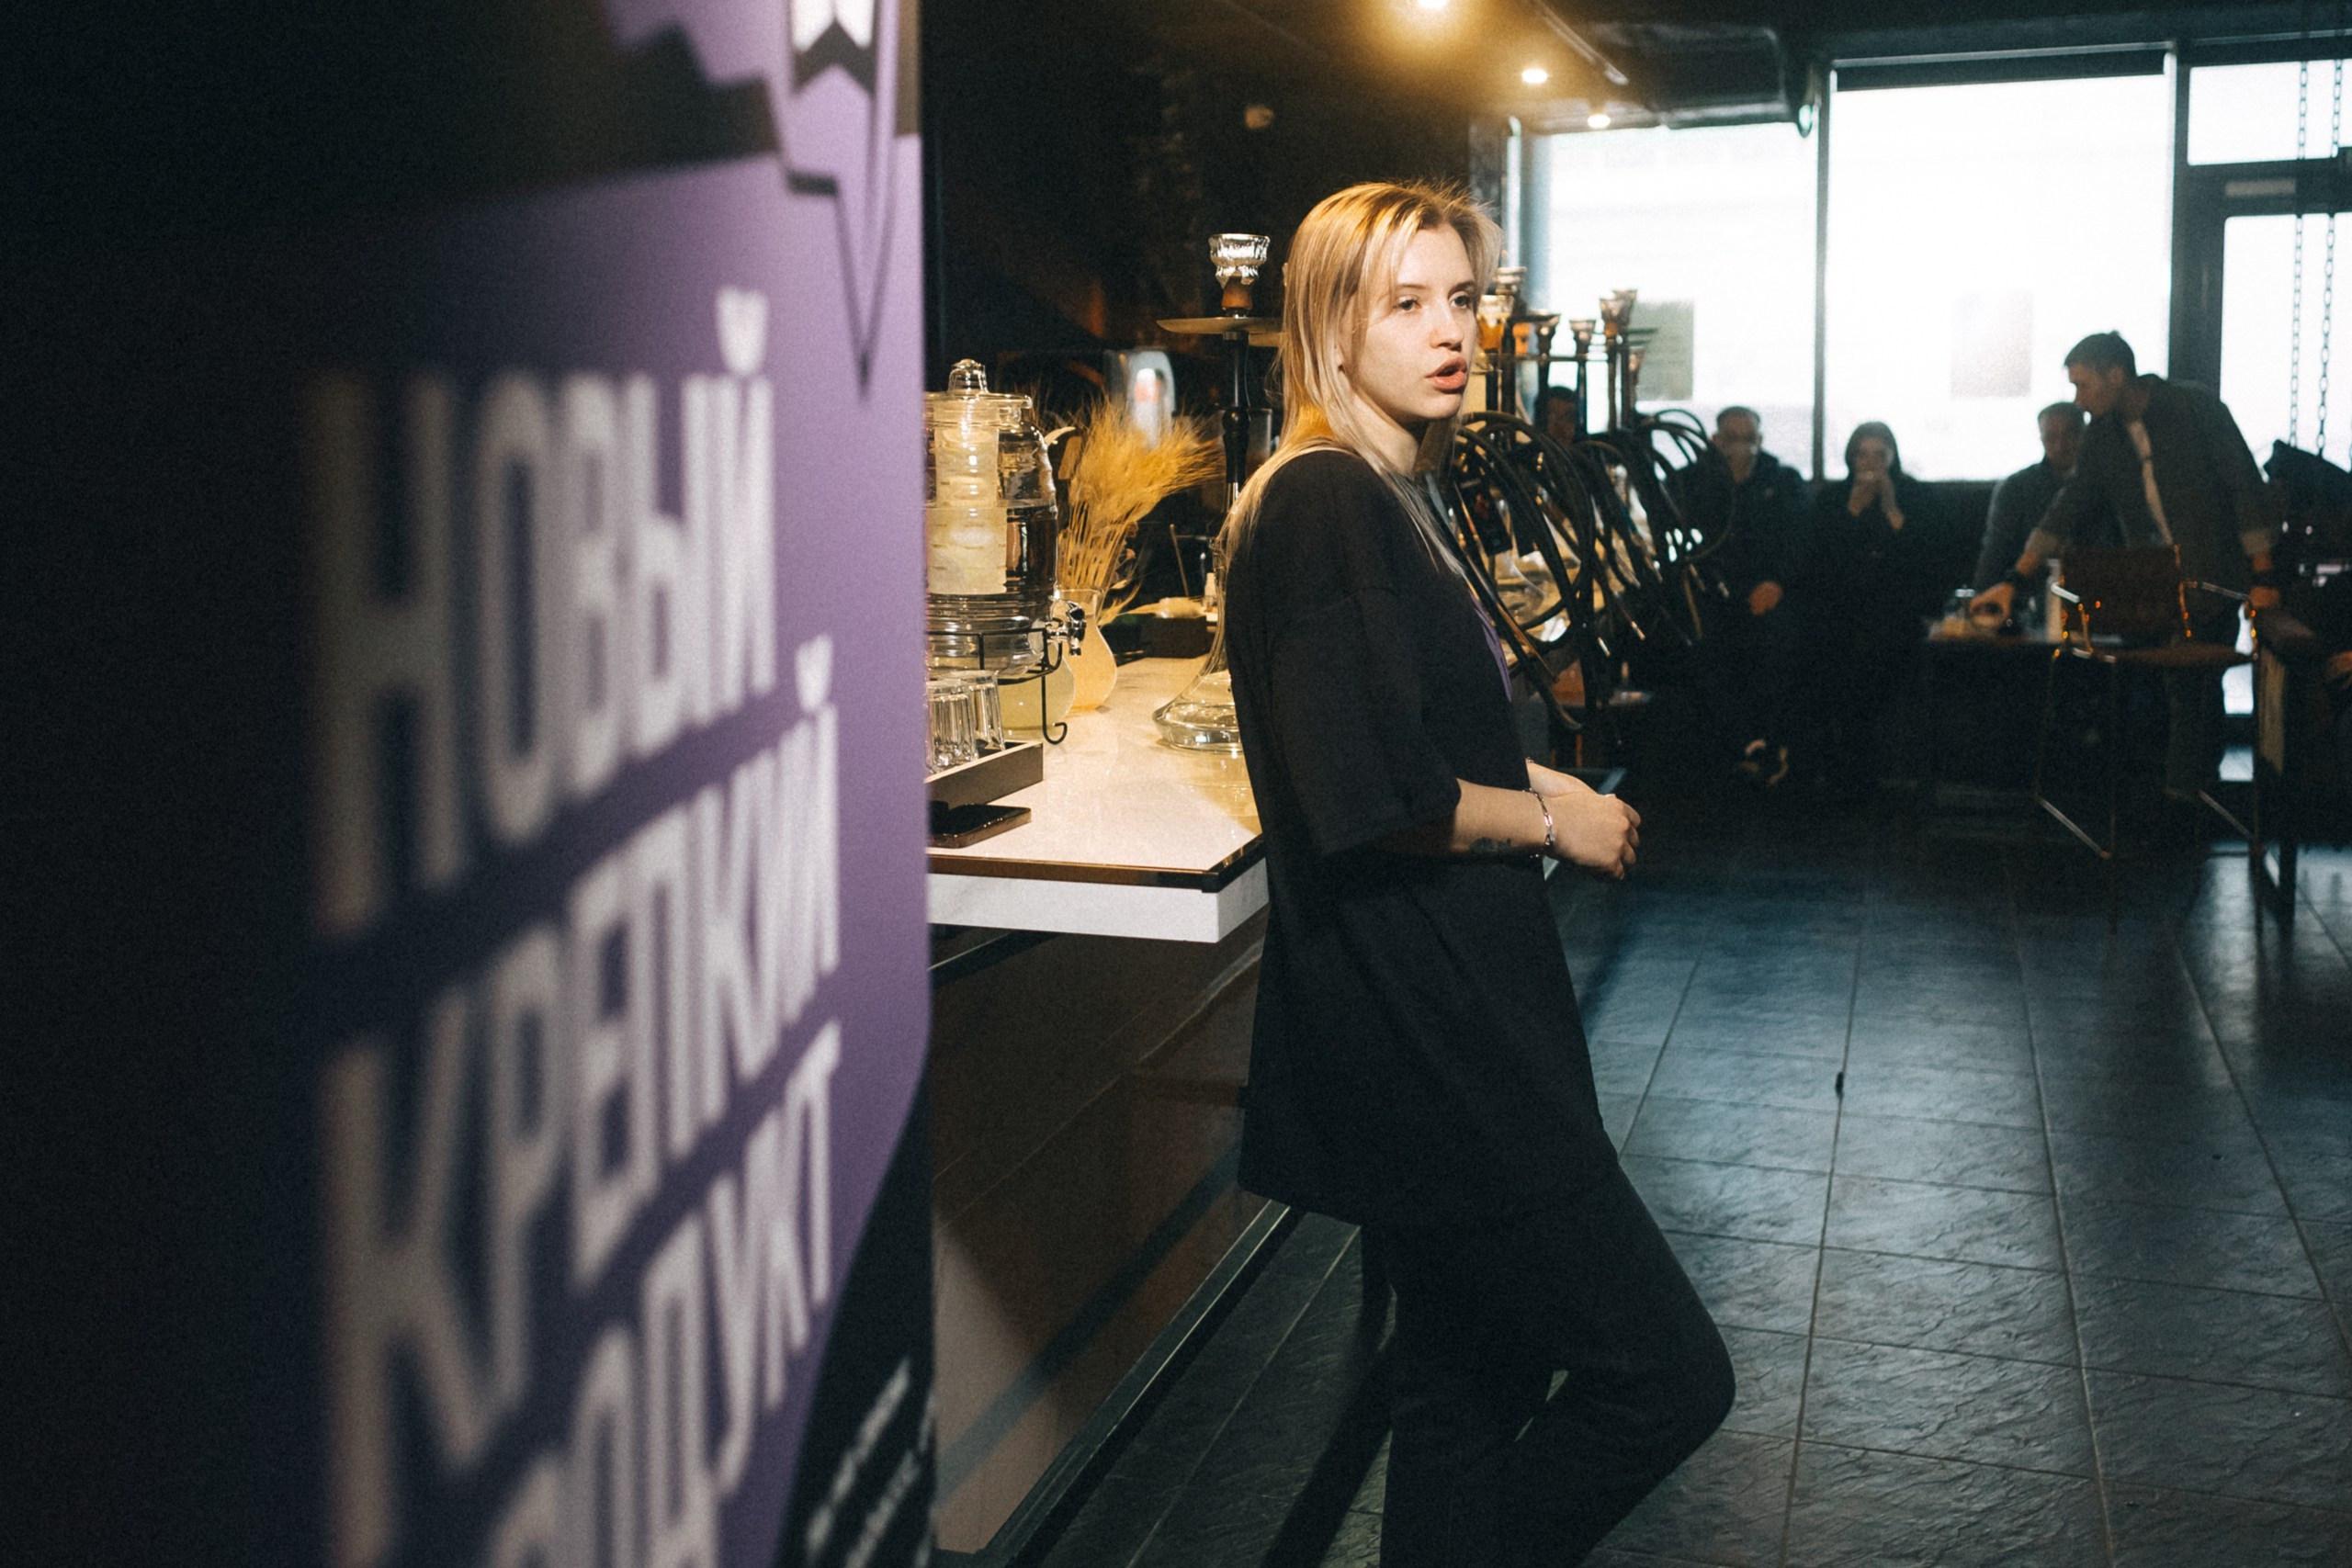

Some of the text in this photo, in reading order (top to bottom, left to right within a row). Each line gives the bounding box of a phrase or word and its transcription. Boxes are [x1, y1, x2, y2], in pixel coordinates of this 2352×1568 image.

[307, 286, 775, 935] НОВЫЙ
[318, 634, 840, 1568] КРЕПКИЙ
[487, 1020, 840, 1568] ОДУКТ
